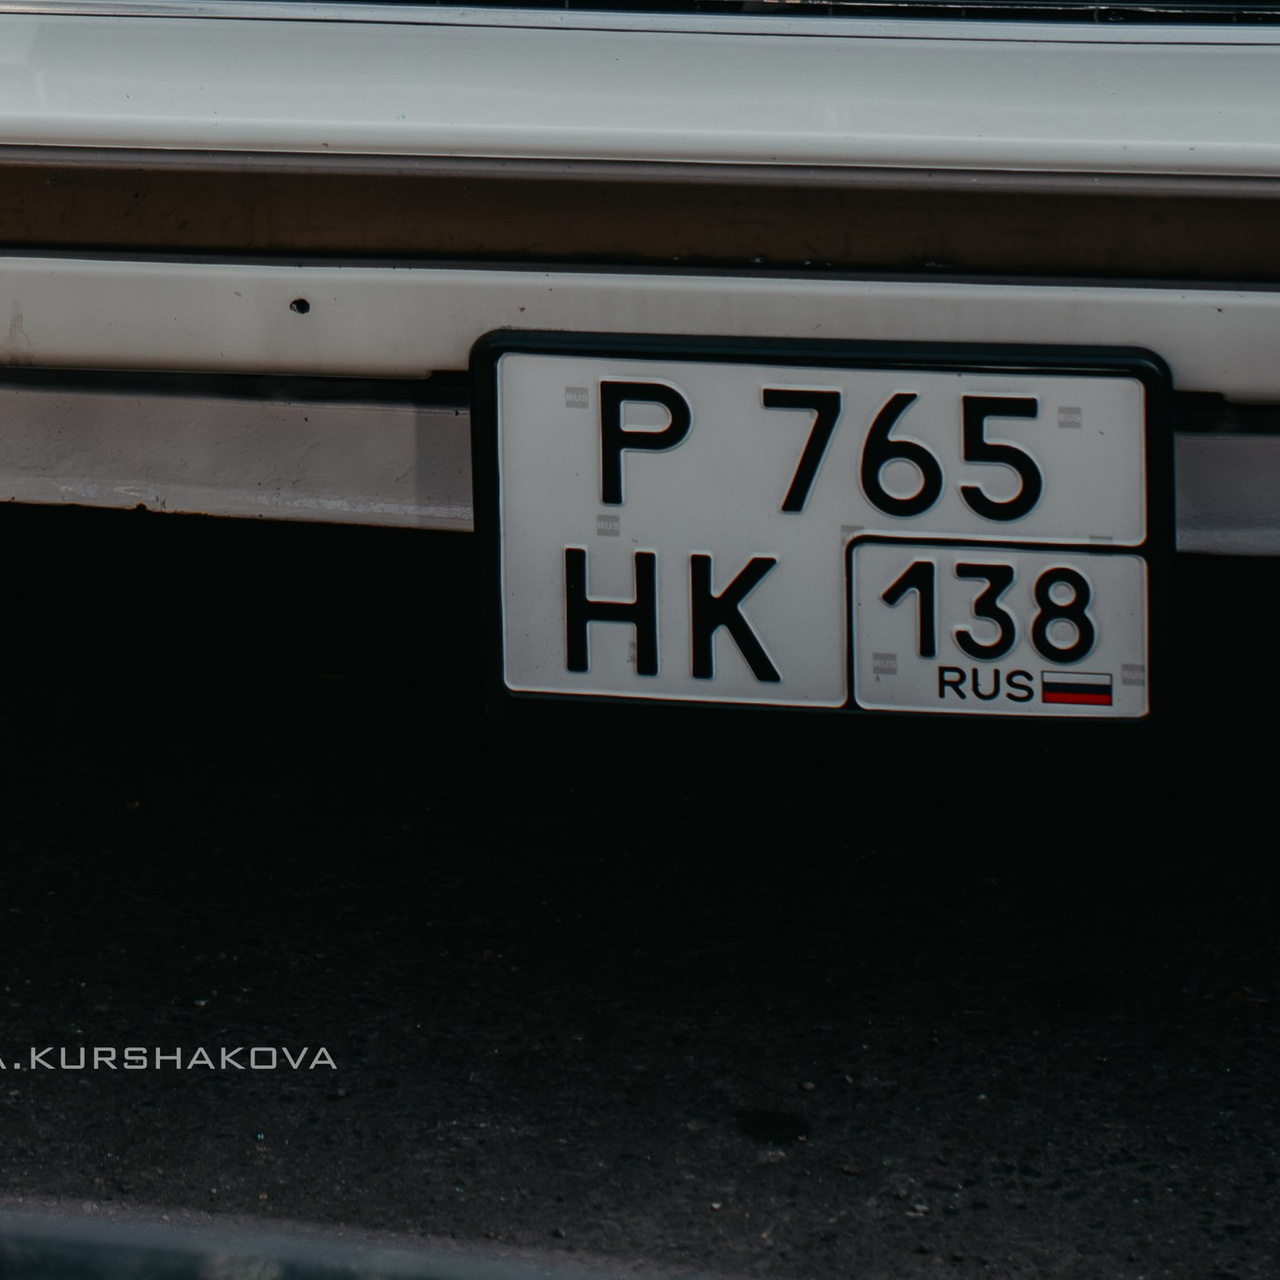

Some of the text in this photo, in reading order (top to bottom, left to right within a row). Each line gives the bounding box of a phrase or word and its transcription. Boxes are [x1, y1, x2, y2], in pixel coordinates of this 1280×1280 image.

[761, 388, 1043, 522] 765
[882, 561, 1095, 664] 138
[938, 666, 1034, 702] RUS
